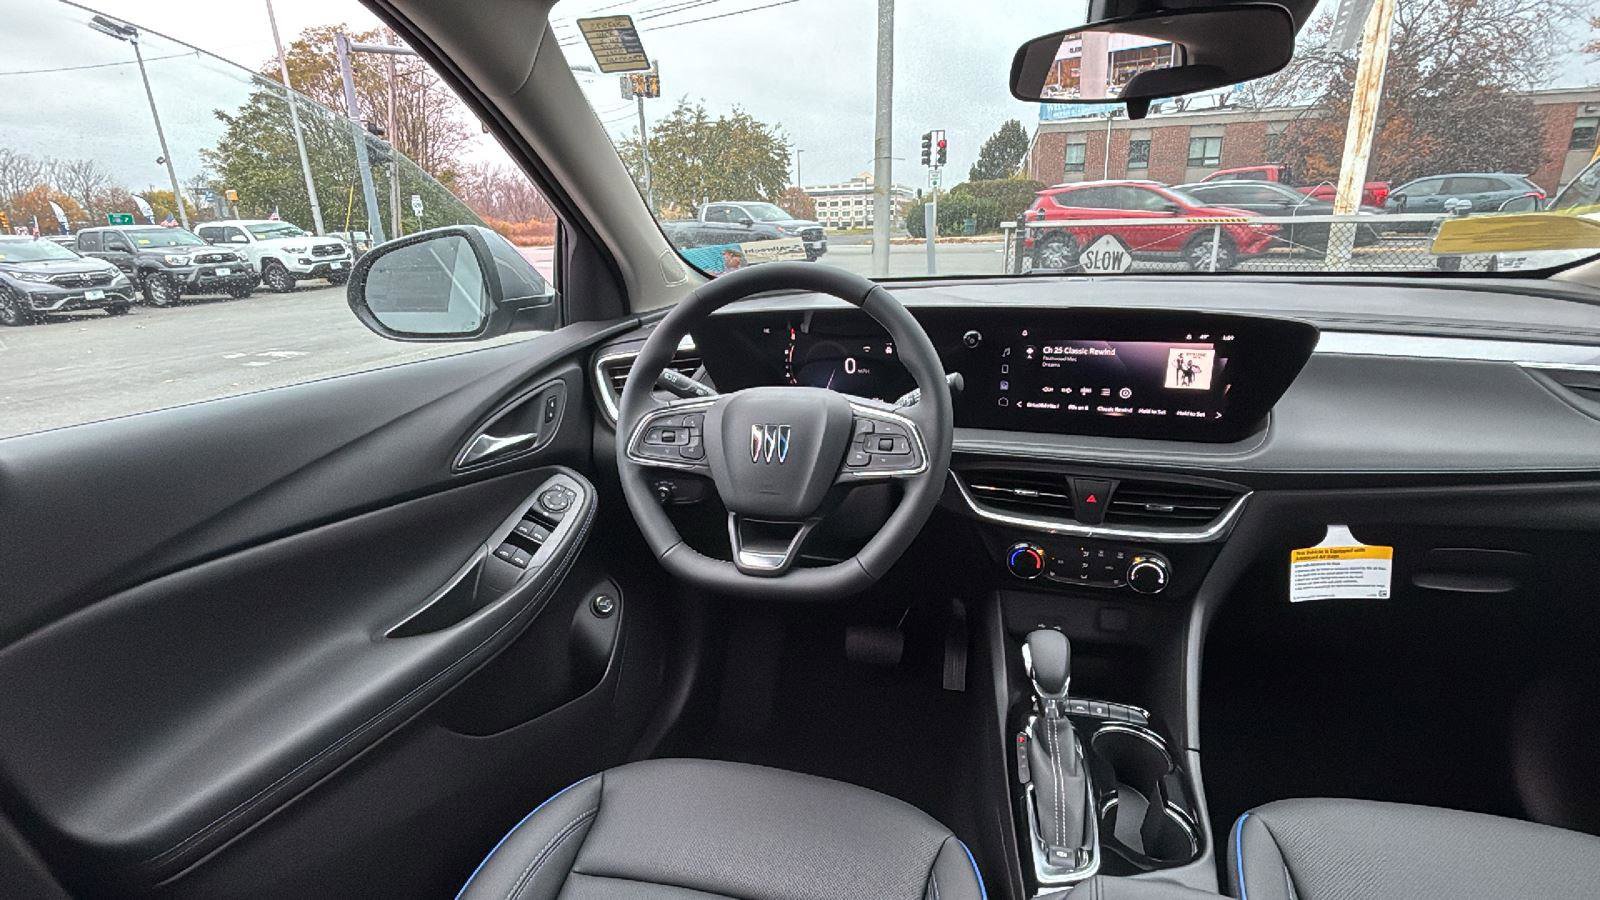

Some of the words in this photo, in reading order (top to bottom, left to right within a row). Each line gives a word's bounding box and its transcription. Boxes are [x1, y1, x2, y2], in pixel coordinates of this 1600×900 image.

[1085, 250, 1124, 271] SLOW
[1042, 346, 1053, 354] Ch
[1053, 346, 1063, 354] 25
[1063, 347, 1088, 355] Classic
[1089, 348, 1116, 356] Rewind
[844, 357, 856, 374] 0
